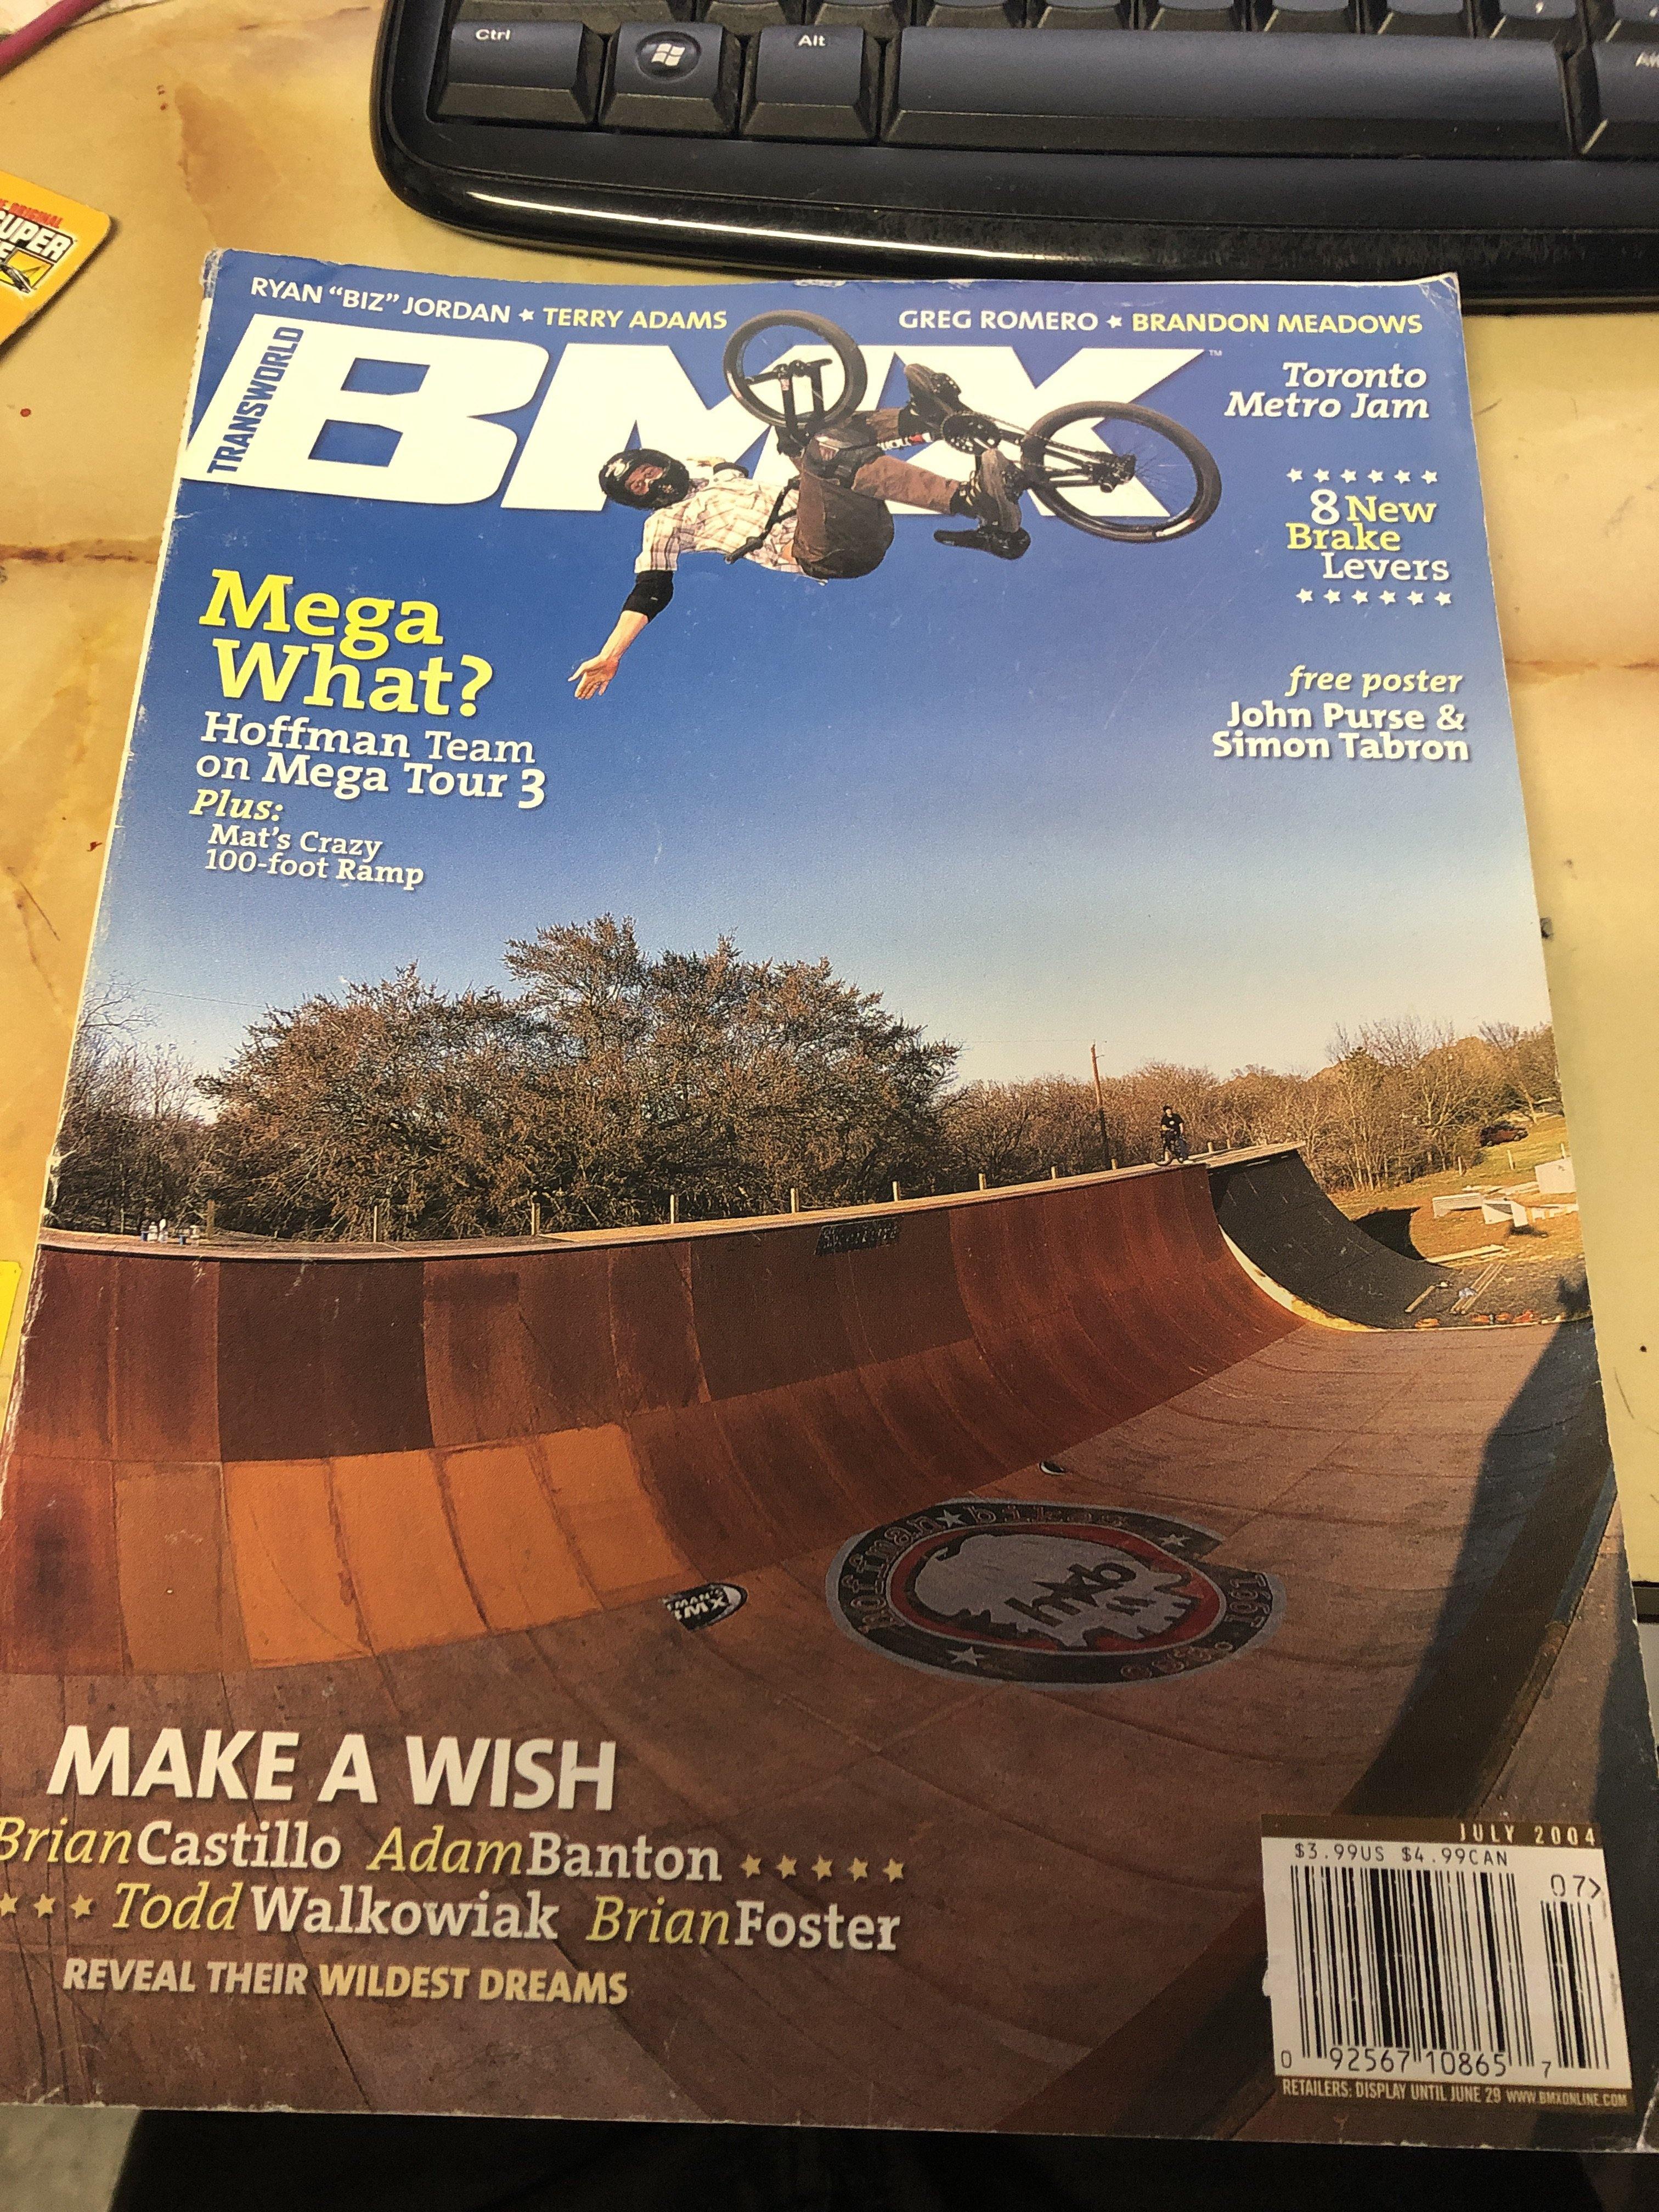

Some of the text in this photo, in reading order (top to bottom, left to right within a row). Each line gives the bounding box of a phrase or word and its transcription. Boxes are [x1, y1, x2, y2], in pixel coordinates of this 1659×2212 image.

[475, 29, 511, 42] Ctrl
[798, 34, 826, 47] Alt
[251, 277, 323, 303] RYAN
[403, 297, 510, 323] JORDAN
[543, 307, 623, 328] TERRY
[629, 311, 727, 330] ADAMS
[899, 311, 972, 329] GREG
[980, 311, 1098, 331] ROMERO
[1132, 313, 1268, 332] BRANDON
[1277, 315, 1423, 334] MEADOWS
[1283, 362, 1426, 388] Toronto
[180, 314, 1205, 516] BMX
[206, 327, 304, 473] TRANSWORLD
[1224, 391, 1429, 419] Metro Jam
[1311, 489, 1437, 525] 8 New
[1285, 522, 1401, 551] Brake
[1321, 552, 1449, 581] Levers
[199, 568, 443, 660] Mega
[212, 638, 493, 717] What?
[1285, 665, 1463, 697] free poster
[1227, 701, 1465, 730] John Purse &
[201, 711, 535, 763] Hoffman Team
[1212, 730, 1469, 760] Simon Tabron
[196, 752, 546, 809] on Mega Tour 3
[189, 789, 284, 821] Plus:
[208, 823, 383, 863] Mat's Crazy
[205, 848, 424, 890] 100-foot Ramp
[46, 1725, 616, 1811] MAKE A WISH
[1459, 1823, 1596, 1846] JULY 2004
[63, 1958, 628, 2005] REVEAL THEIR WILDEST DREAMS
[1281, 2048, 1552, 2079] 0 92567 10865 7
[1283, 2078, 1352, 2097] RETAILERS:
[1356, 2082, 1407, 2100] DISPLAY
[1411, 2084, 1447, 2102] UNTIL
[1450, 2086, 1481, 2103] JUNE
